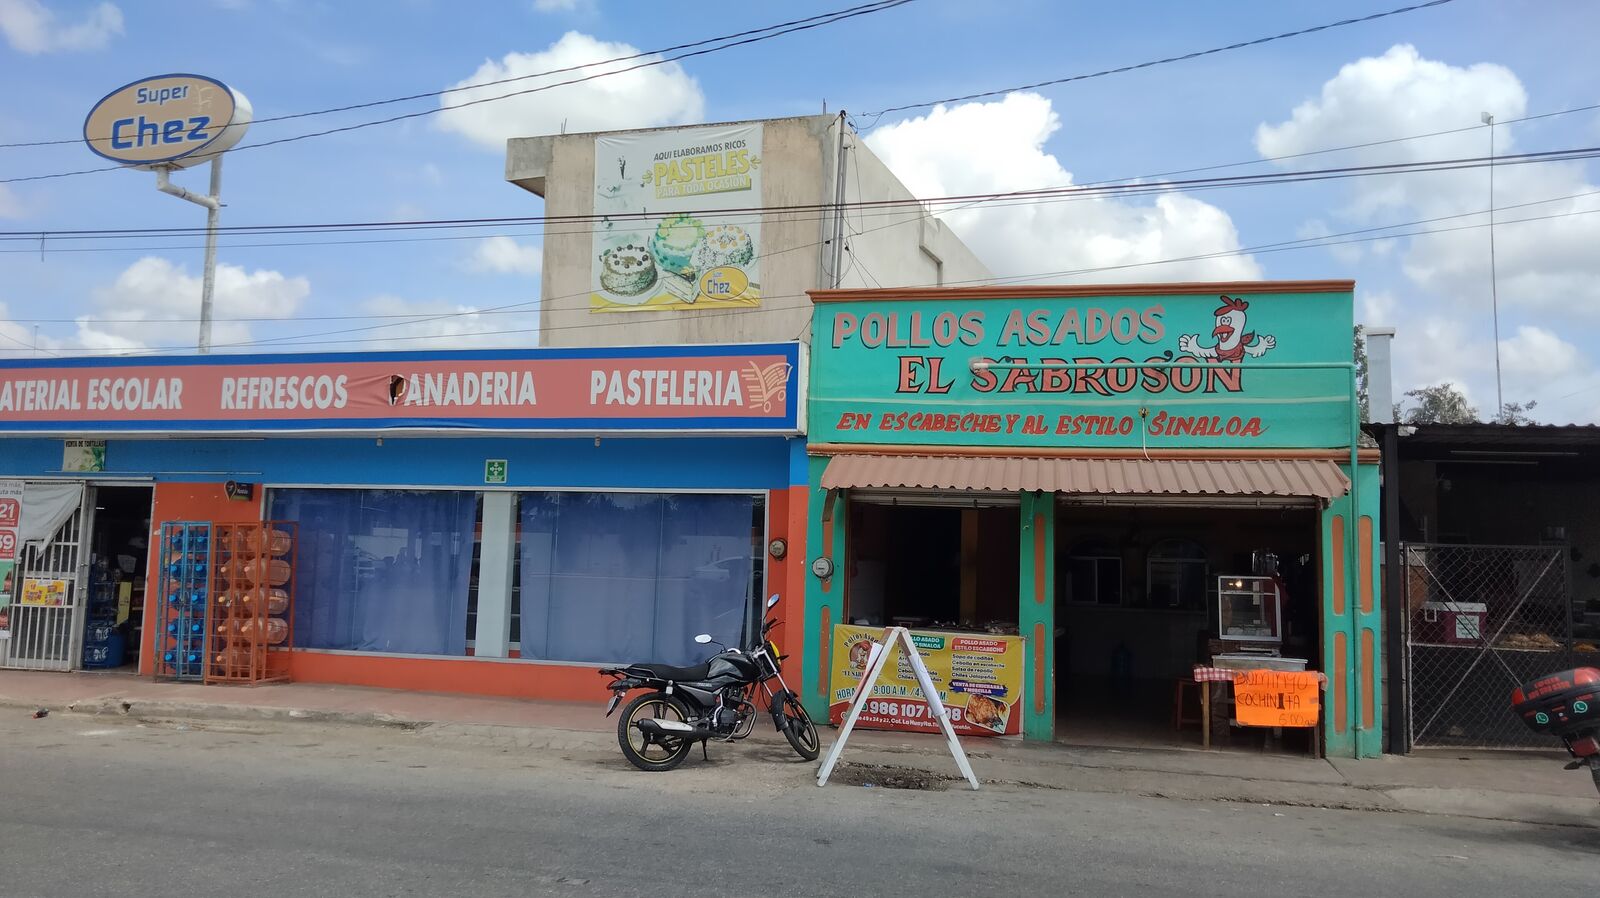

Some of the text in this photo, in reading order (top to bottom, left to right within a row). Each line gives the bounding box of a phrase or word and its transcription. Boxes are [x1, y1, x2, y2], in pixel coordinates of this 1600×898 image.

[137, 85, 189, 105] Super
[111, 115, 210, 150] Chez
[673, 143, 723, 159] ELABORAMOS
[724, 139, 746, 151] RICOS
[654, 149, 751, 187] PASTELES
[656, 185, 680, 198] PARA
[683, 182, 704, 194] TODA
[707, 279, 730, 294] Chez
[831, 304, 1166, 349] POLLOS ASADOS
[590, 369, 744, 407] PASTELERIA
[895, 355, 957, 395] EL
[86, 377, 183, 410] ESCOLAR
[220, 374, 348, 410] REFRESCOS
[836, 410, 1271, 437] EN ESCABECHE Y AL ESTILO SINALOA
[873, 685, 890, 695] 9:00
[869, 701, 898, 716] 986
[900, 703, 925, 718] 107
